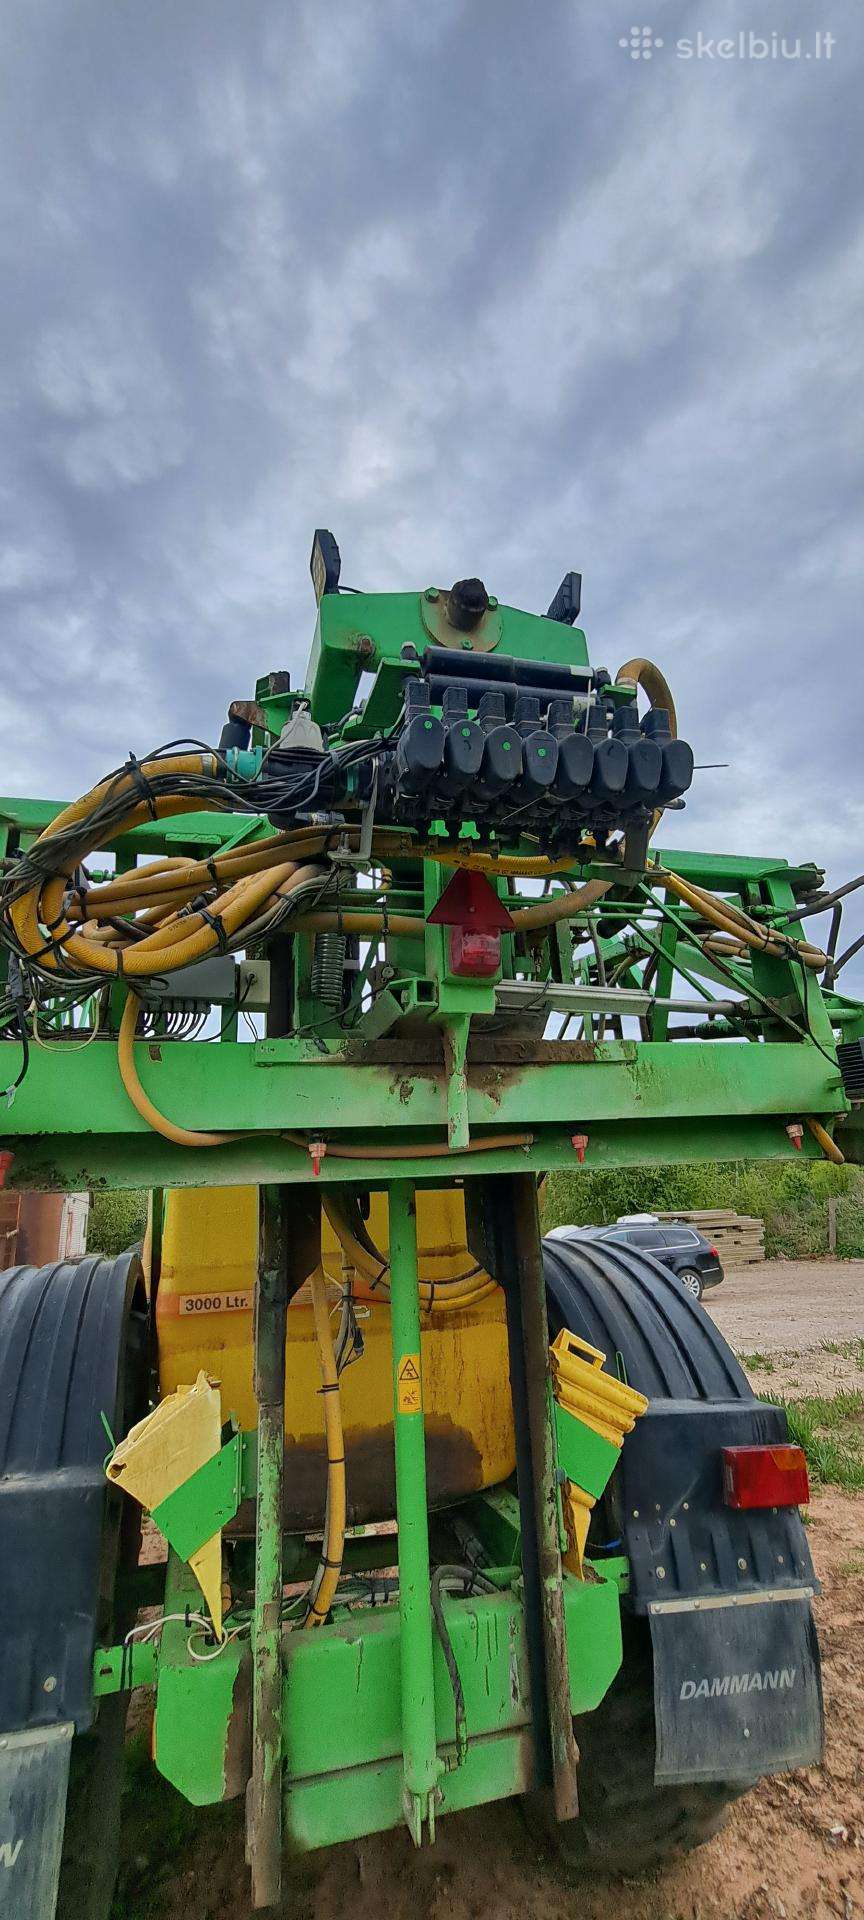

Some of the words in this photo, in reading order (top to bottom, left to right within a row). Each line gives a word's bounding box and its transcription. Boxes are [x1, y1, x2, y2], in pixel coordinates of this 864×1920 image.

[185, 1297, 222, 1311] 3000
[226, 1295, 248, 1308] Ltr.
[679, 1668, 796, 1700] DAMMANN
